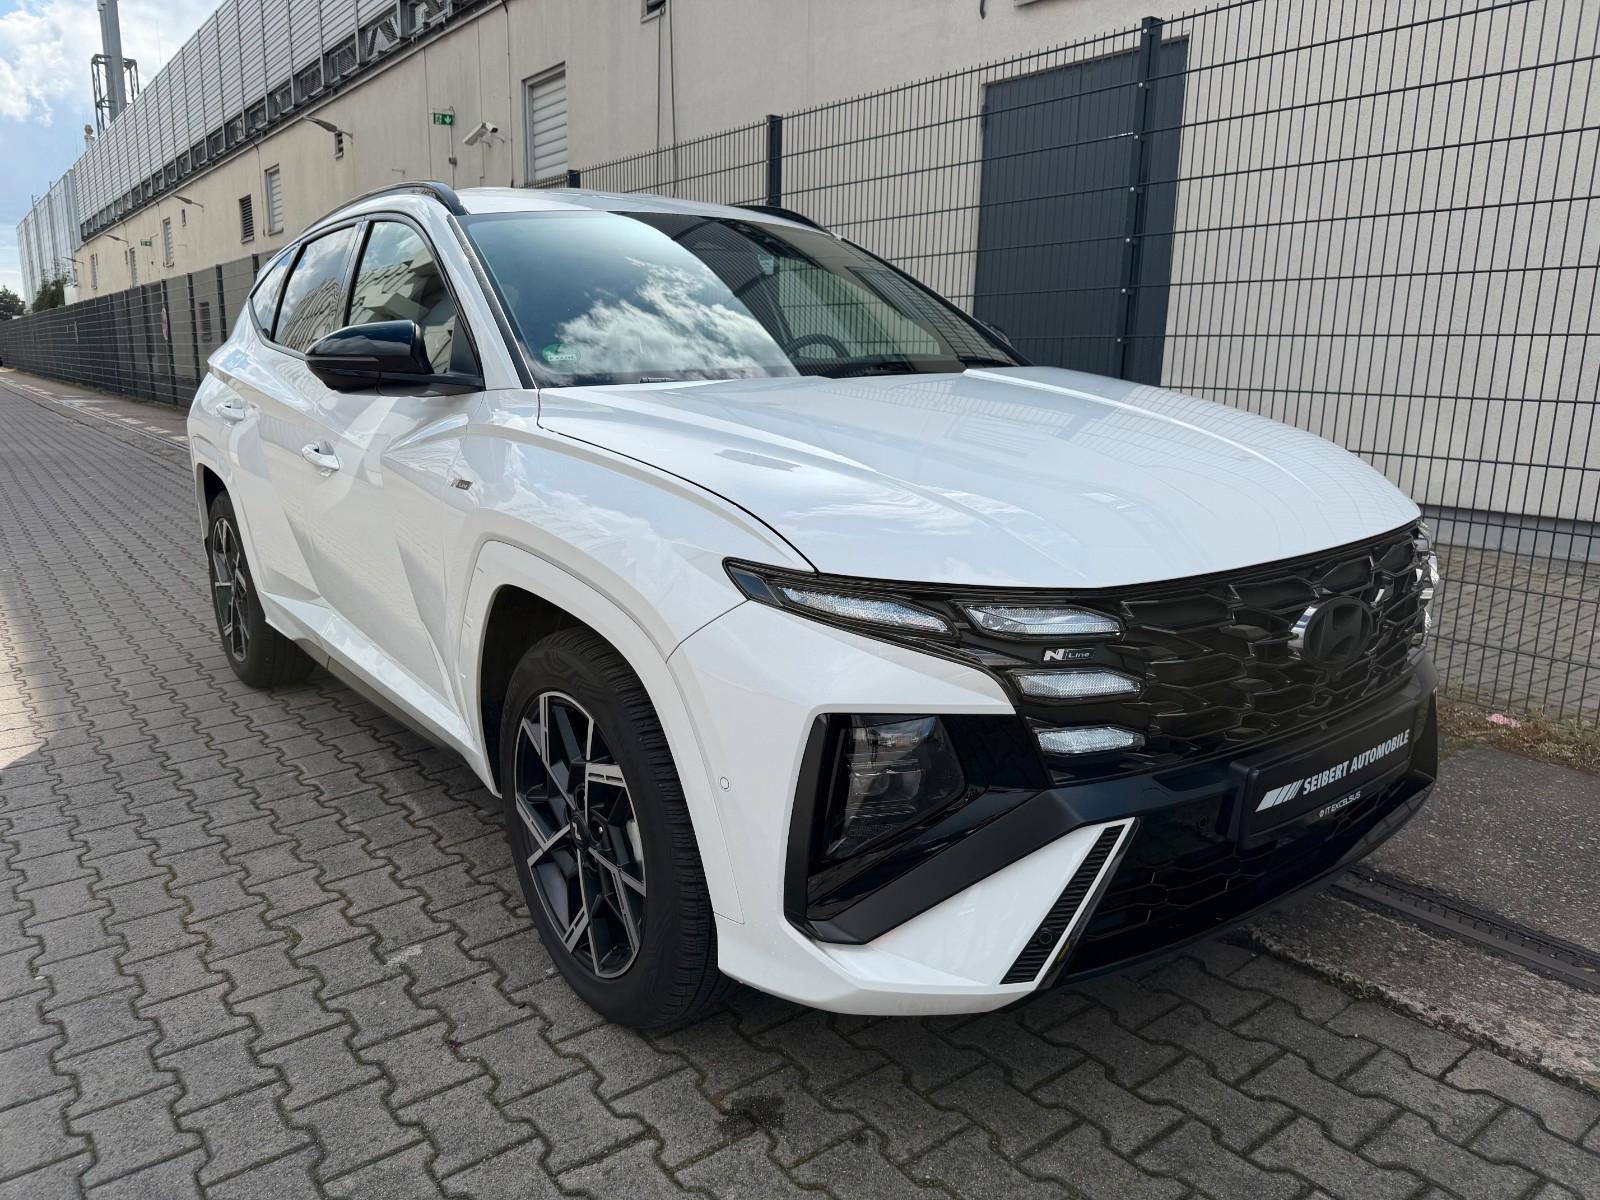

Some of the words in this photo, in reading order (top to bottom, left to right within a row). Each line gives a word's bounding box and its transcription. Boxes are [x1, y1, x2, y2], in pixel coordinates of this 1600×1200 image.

[1044, 648, 1065, 661] N
[1303, 760, 1350, 795] SEIBERT
[1350, 729, 1410, 773] AUTOMOBILE
